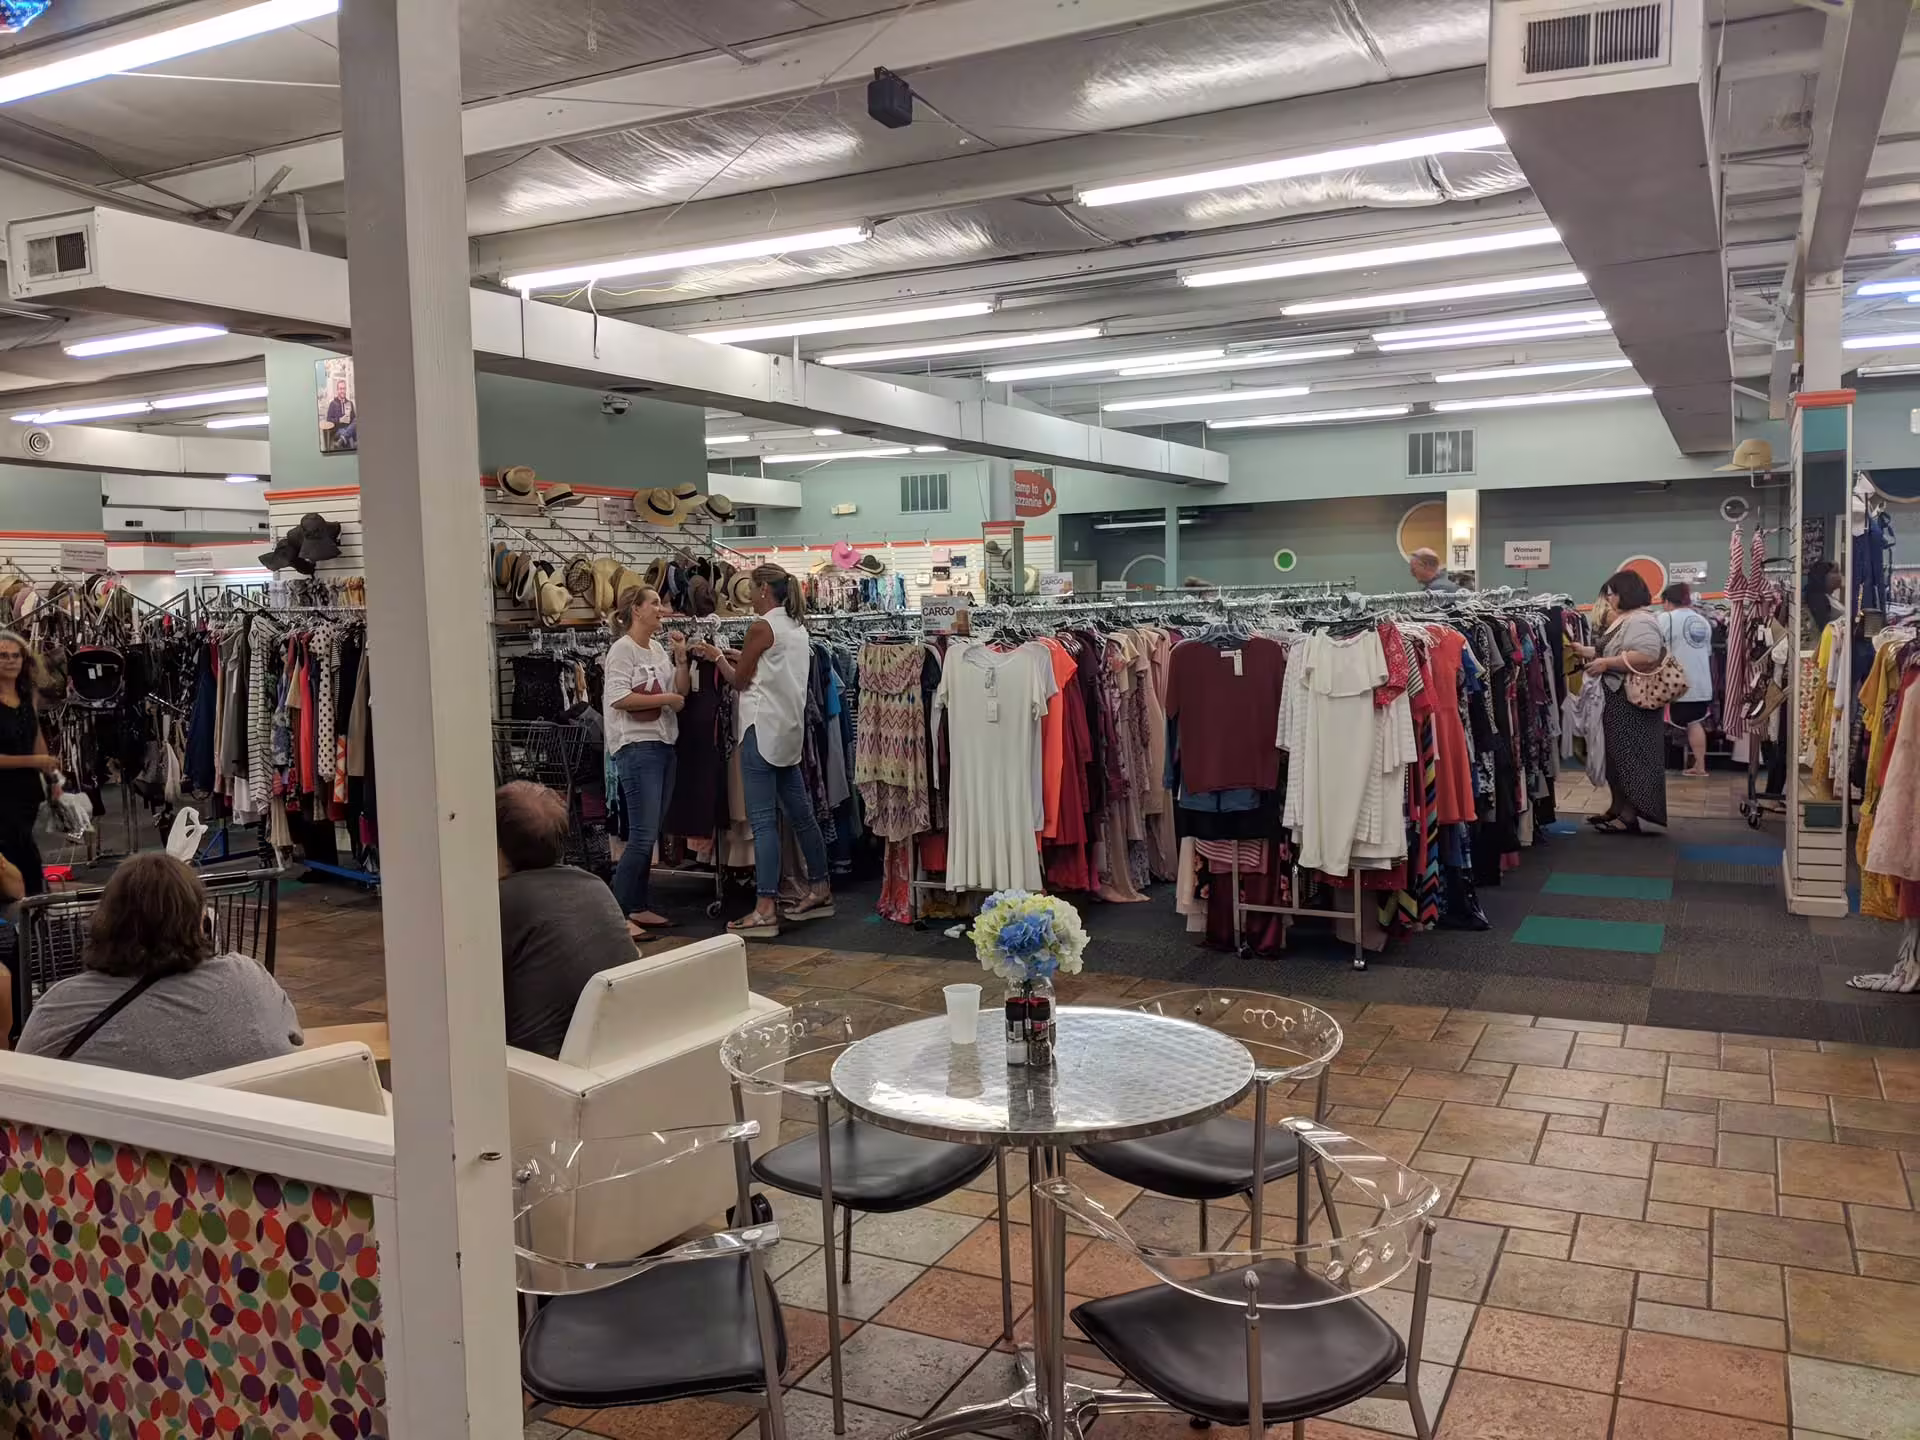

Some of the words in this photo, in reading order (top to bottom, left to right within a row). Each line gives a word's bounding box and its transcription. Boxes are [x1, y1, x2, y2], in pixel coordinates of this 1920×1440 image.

[1016, 482, 1030, 494] amp
[1031, 482, 1039, 494] to
[1671, 567, 1698, 575] CARGO
[1041, 578, 1063, 586] CARGO
[922, 606, 955, 617] CARGO
